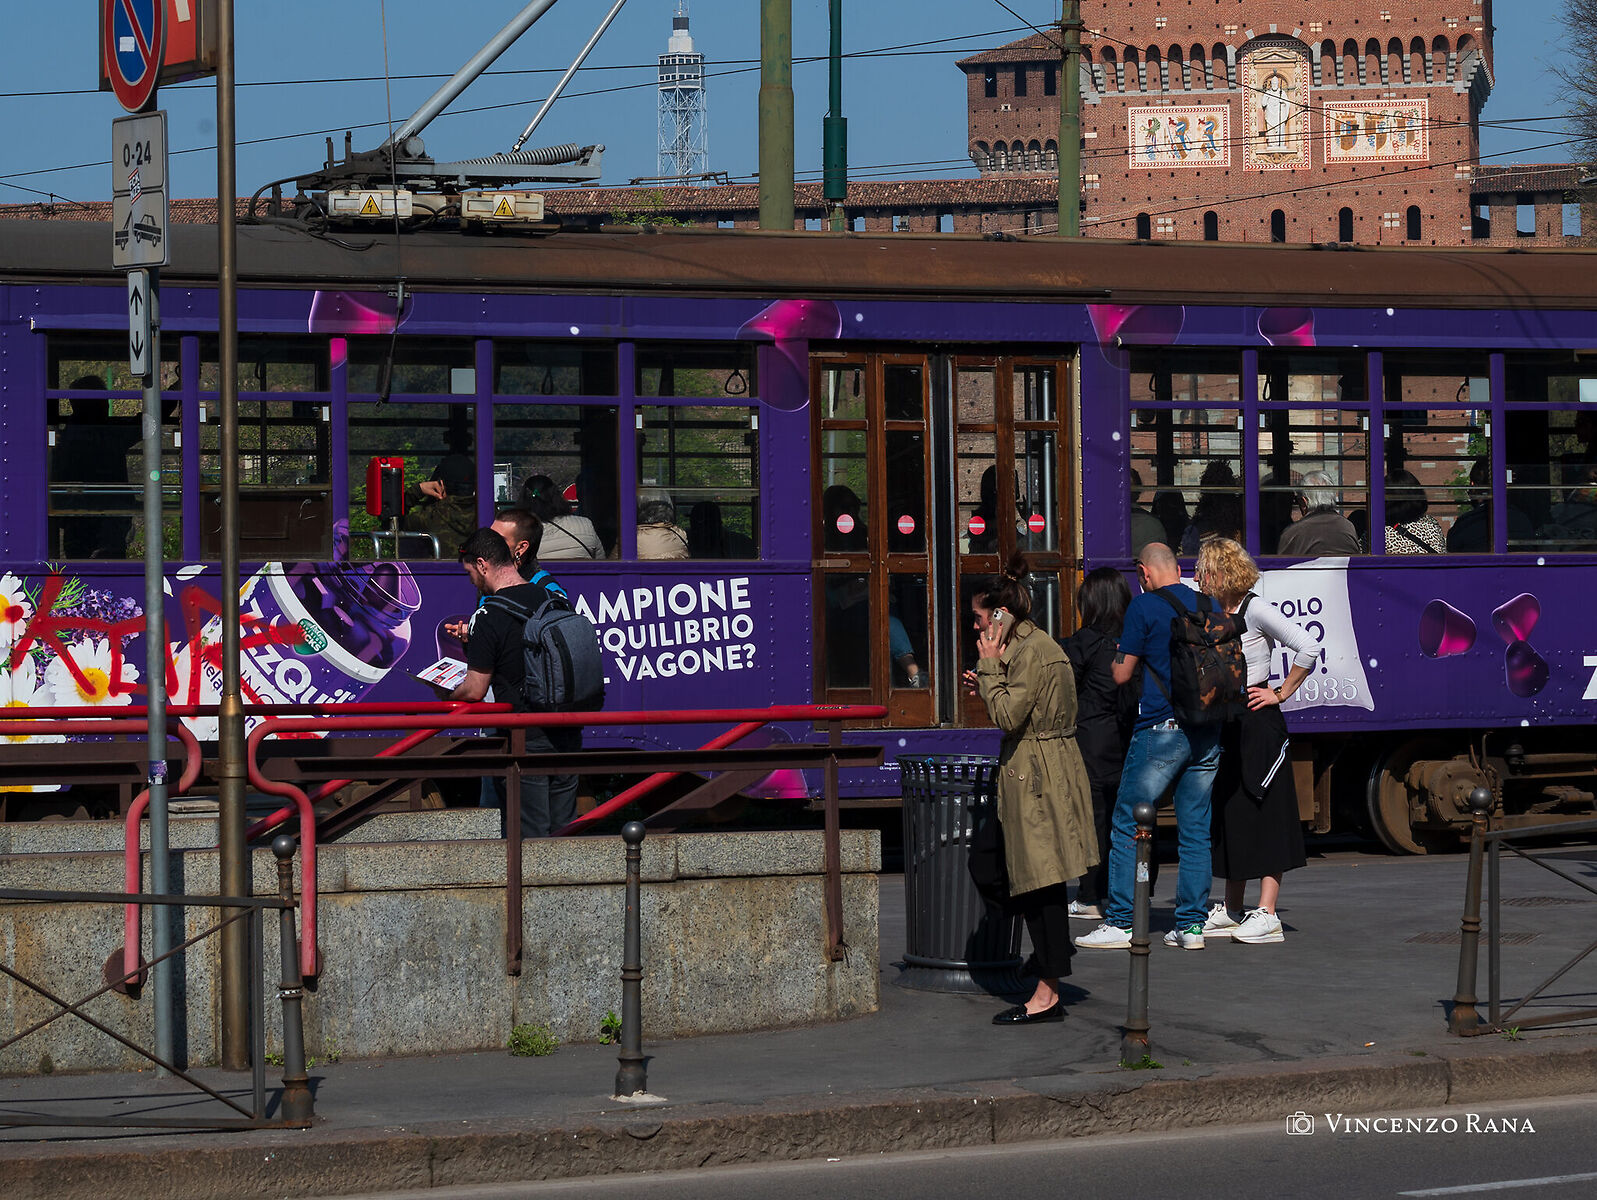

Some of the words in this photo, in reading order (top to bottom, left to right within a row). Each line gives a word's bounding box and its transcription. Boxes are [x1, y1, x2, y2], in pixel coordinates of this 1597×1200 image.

[123, 140, 152, 168] 0-24
[575, 577, 751, 624] AMPIONE
[1271, 597, 1323, 618] OLO
[615, 643, 756, 682] VAGONE?
[1295, 677, 1358, 702] 1935
